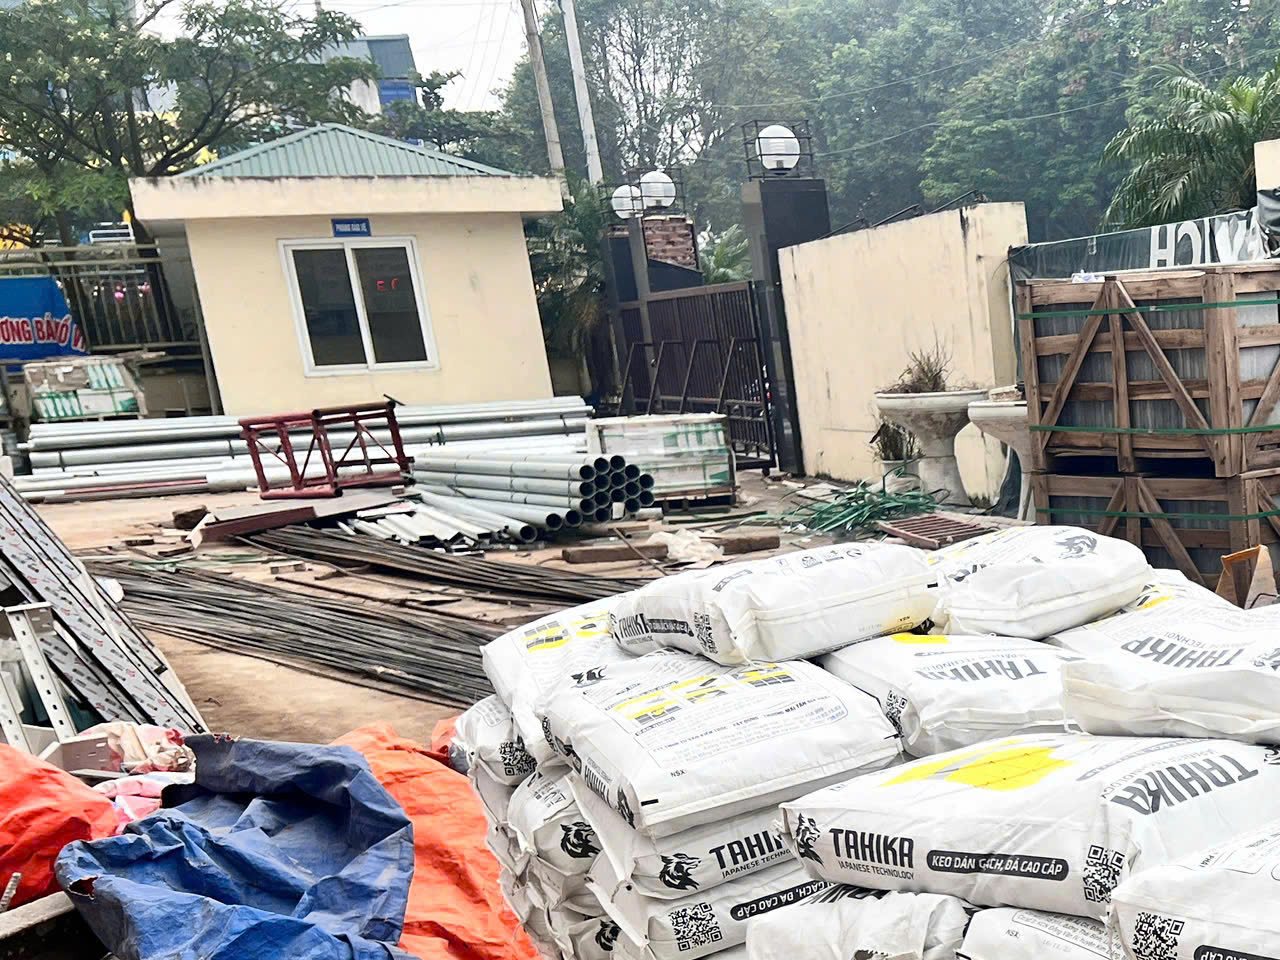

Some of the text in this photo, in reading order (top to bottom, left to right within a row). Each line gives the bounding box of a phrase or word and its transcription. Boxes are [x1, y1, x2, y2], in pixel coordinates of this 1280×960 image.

[1111, 755, 1259, 815] TAHIKA
[829, 828, 914, 869] TAHIKA
[722, 861, 760, 878] JAPANESE
[838, 860, 915, 880] JAPANESE TECHNOLOGY
[932, 855, 952, 868] KEO
[953, 854, 976, 869] DÁN
[1020, 861, 1040, 874] CAO
[1041, 859, 1064, 876] CẤP
[759, 900, 778, 911] CAO
[780, 894, 794, 904] ĐÁ
[737, 903, 757, 918] CẤP
